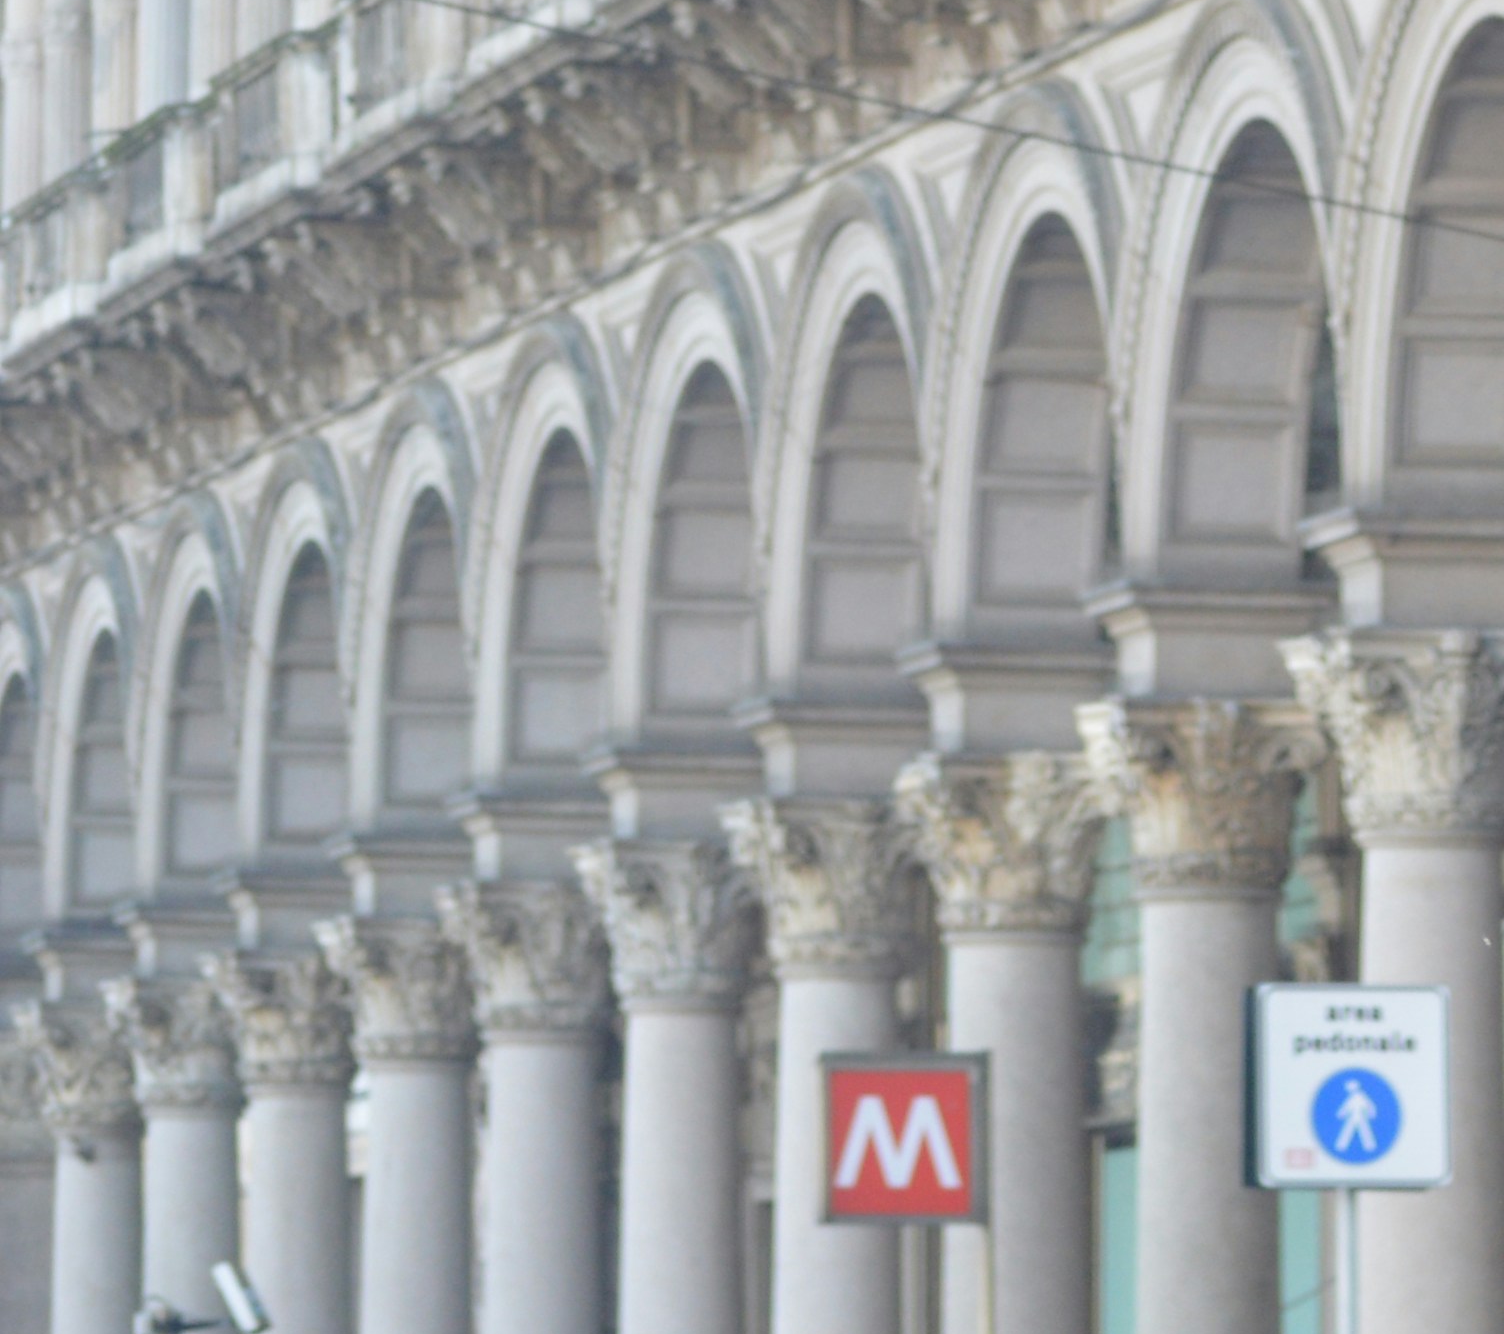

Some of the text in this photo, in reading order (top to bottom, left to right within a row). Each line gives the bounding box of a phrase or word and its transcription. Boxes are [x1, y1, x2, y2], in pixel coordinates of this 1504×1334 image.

[1327, 1004, 1382, 1022] area
[1292, 1032, 1417, 1056] pedonale
[836, 1095, 962, 1189] M
